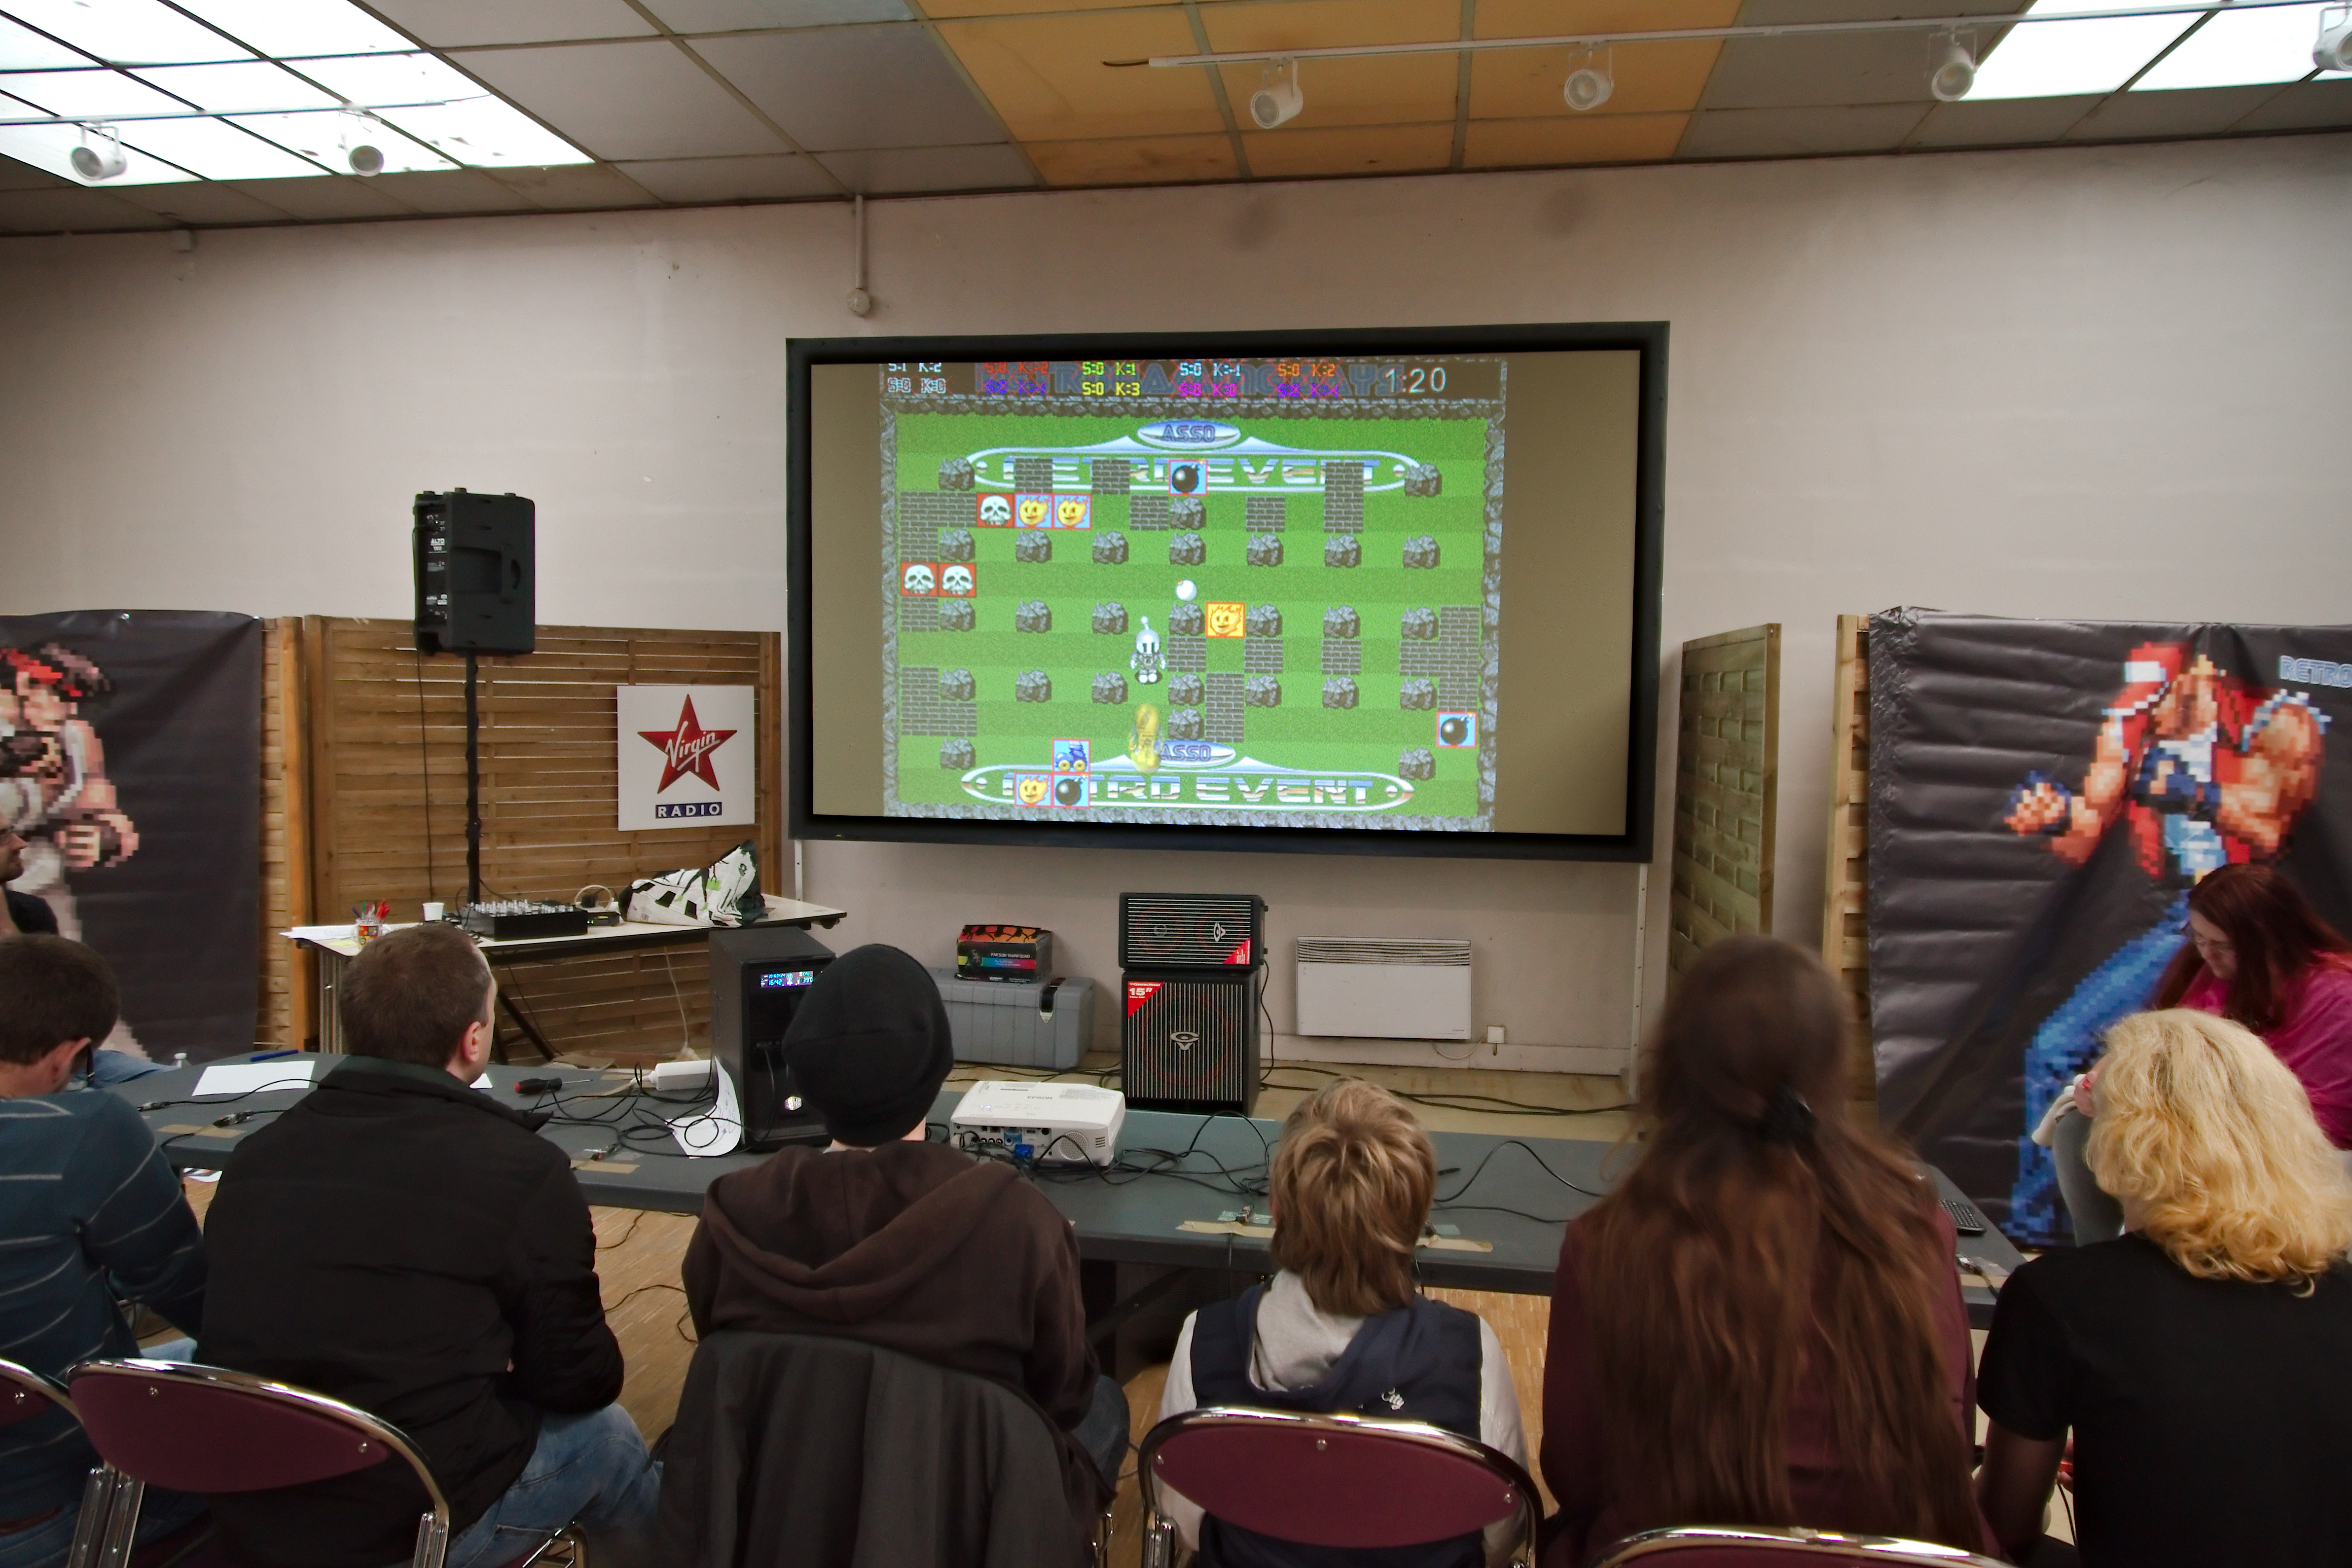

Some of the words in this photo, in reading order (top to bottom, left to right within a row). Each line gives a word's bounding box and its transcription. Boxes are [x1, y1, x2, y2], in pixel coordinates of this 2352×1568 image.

[1082, 362, 1104, 376] S:0
[1180, 362, 1202, 377] S:0
[1082, 381, 1104, 396] S:0
[1115, 381, 1140, 396] K:3
[1386, 366, 1447, 394] 1:20
[1161, 424, 1216, 442] ASSO
[2280, 655, 2352, 689] RETRO
[665, 721, 718, 773] Virgin
[1160, 744, 1211, 762] ASSO
[1196, 777, 1374, 804] EVENT
[657, 803, 721, 818] RADIO
